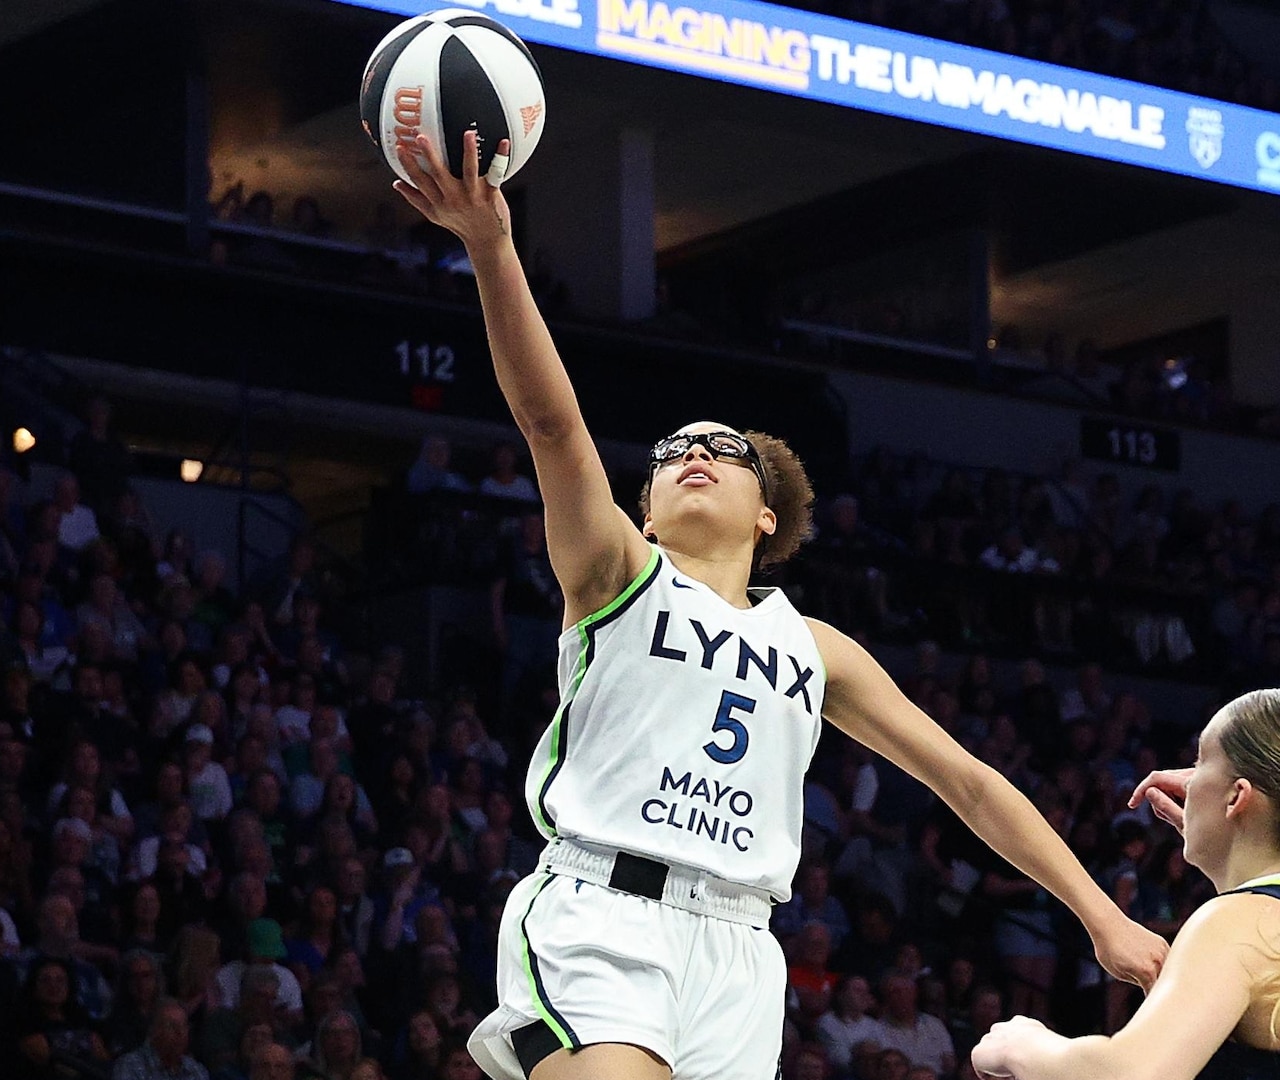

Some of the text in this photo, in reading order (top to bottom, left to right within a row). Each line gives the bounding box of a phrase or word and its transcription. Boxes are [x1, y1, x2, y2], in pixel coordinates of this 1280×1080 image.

[596, 0, 811, 73] IMAGINING
[810, 34, 893, 93] THE
[892, 52, 1165, 149] UNIMAGINABLE
[396, 341, 455, 381] 112
[1109, 429, 1156, 462] 113
[649, 610, 814, 714] LYNX
[702, 689, 757, 765] 5
[660, 766, 753, 817] MAYO
[641, 798, 754, 852] CLINIC
